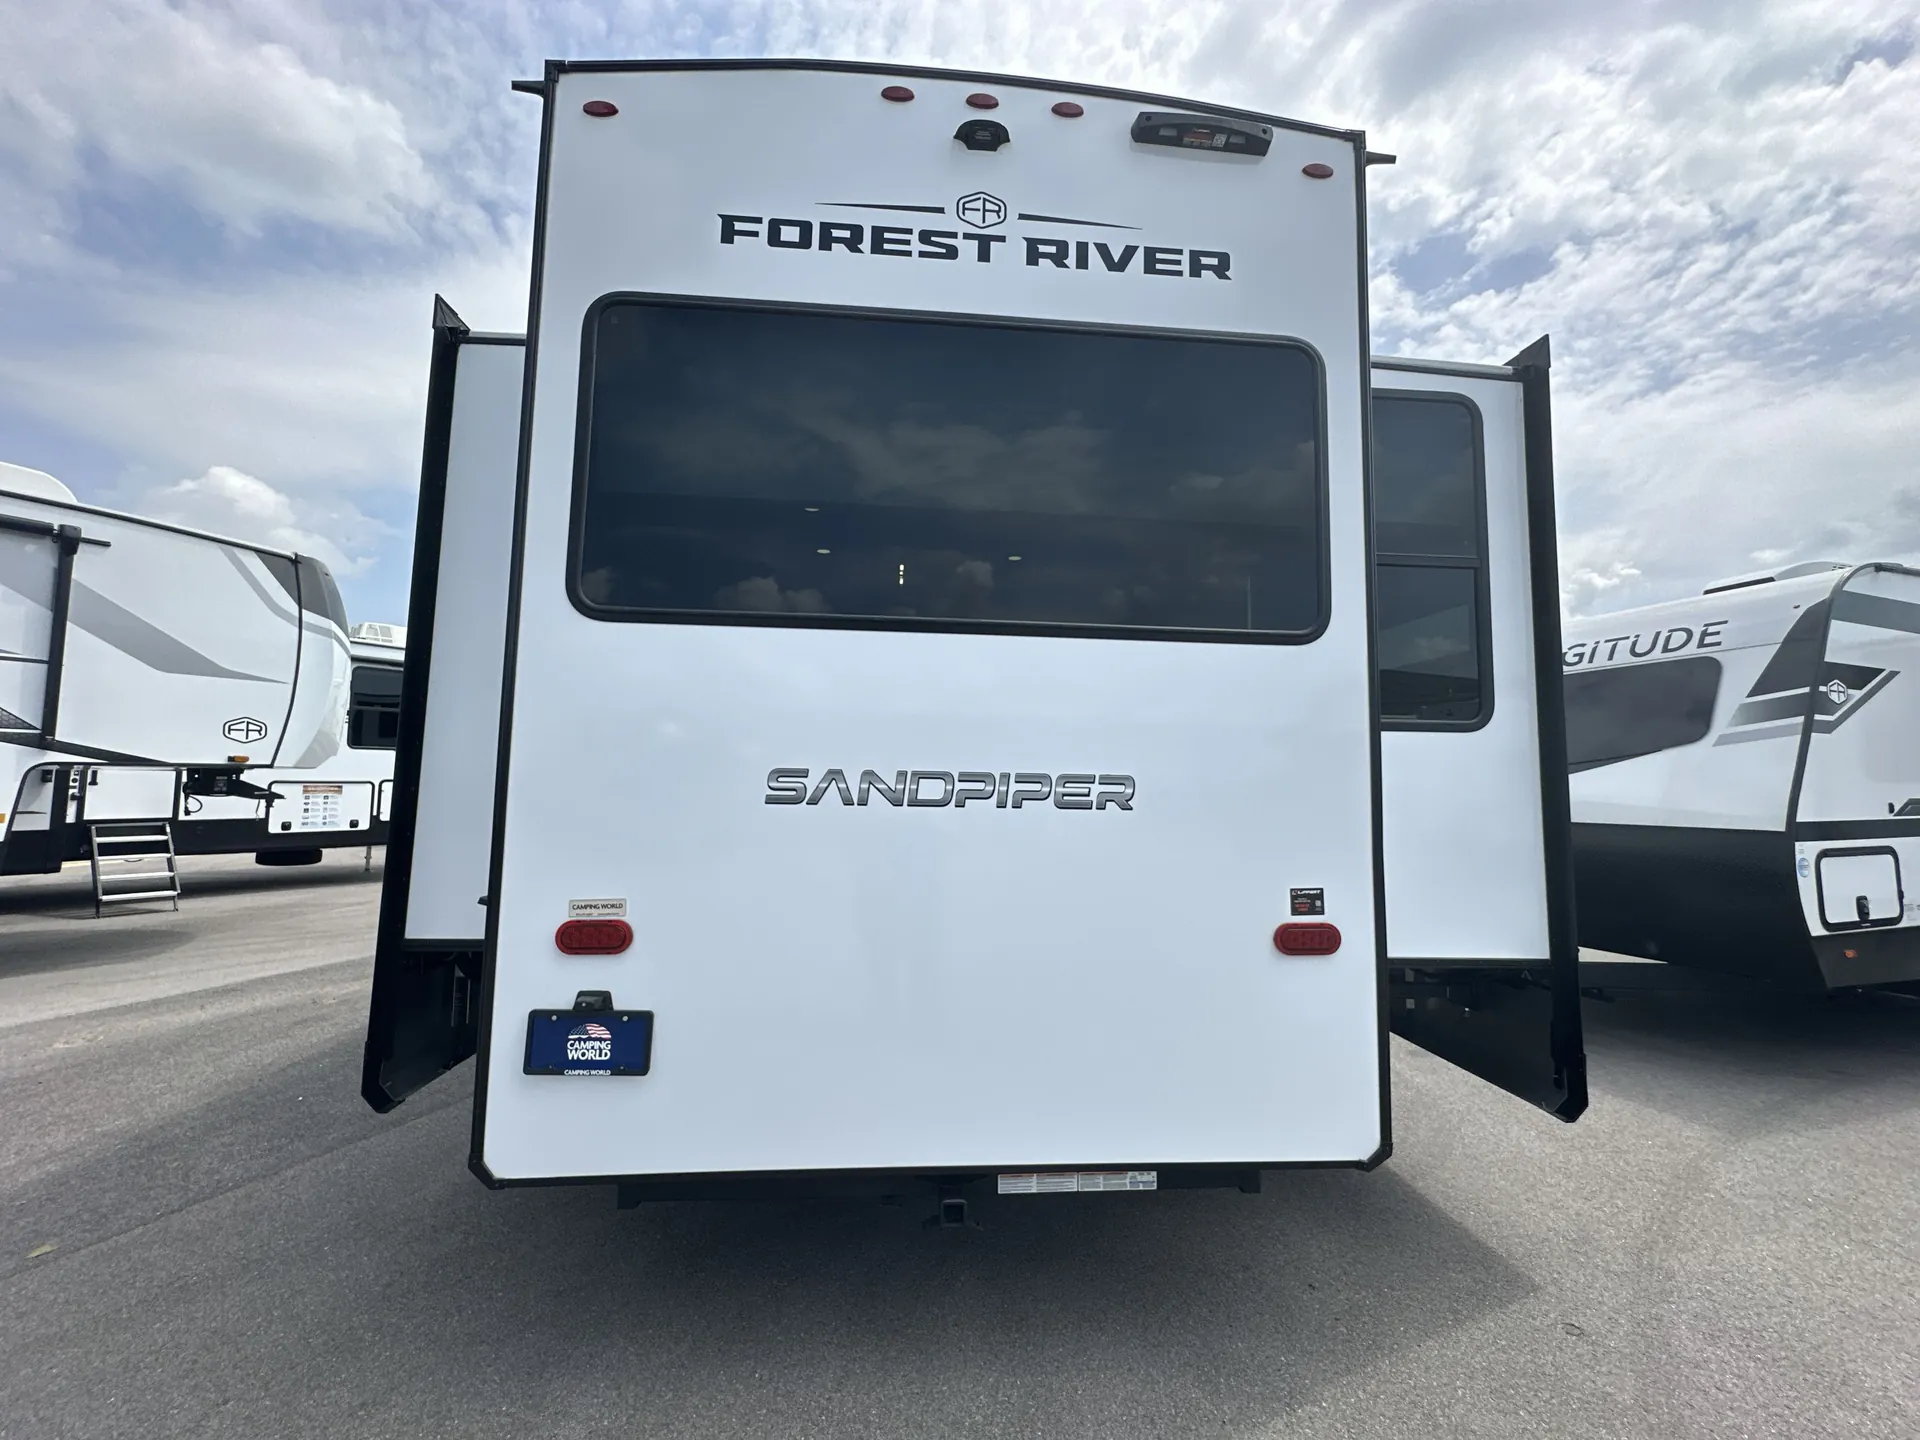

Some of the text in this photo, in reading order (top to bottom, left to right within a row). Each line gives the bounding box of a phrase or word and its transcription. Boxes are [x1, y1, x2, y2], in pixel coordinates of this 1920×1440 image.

[717, 213, 1232, 281] FOREST RIVER
[1562, 620, 1729, 667] GITUDE
[764, 768, 1136, 811] SANDPIPER
[572, 902, 624, 911] CAMPING WORLD
[566, 1040, 611, 1050] CAMPING
[567, 1049, 611, 1060] WORLD
